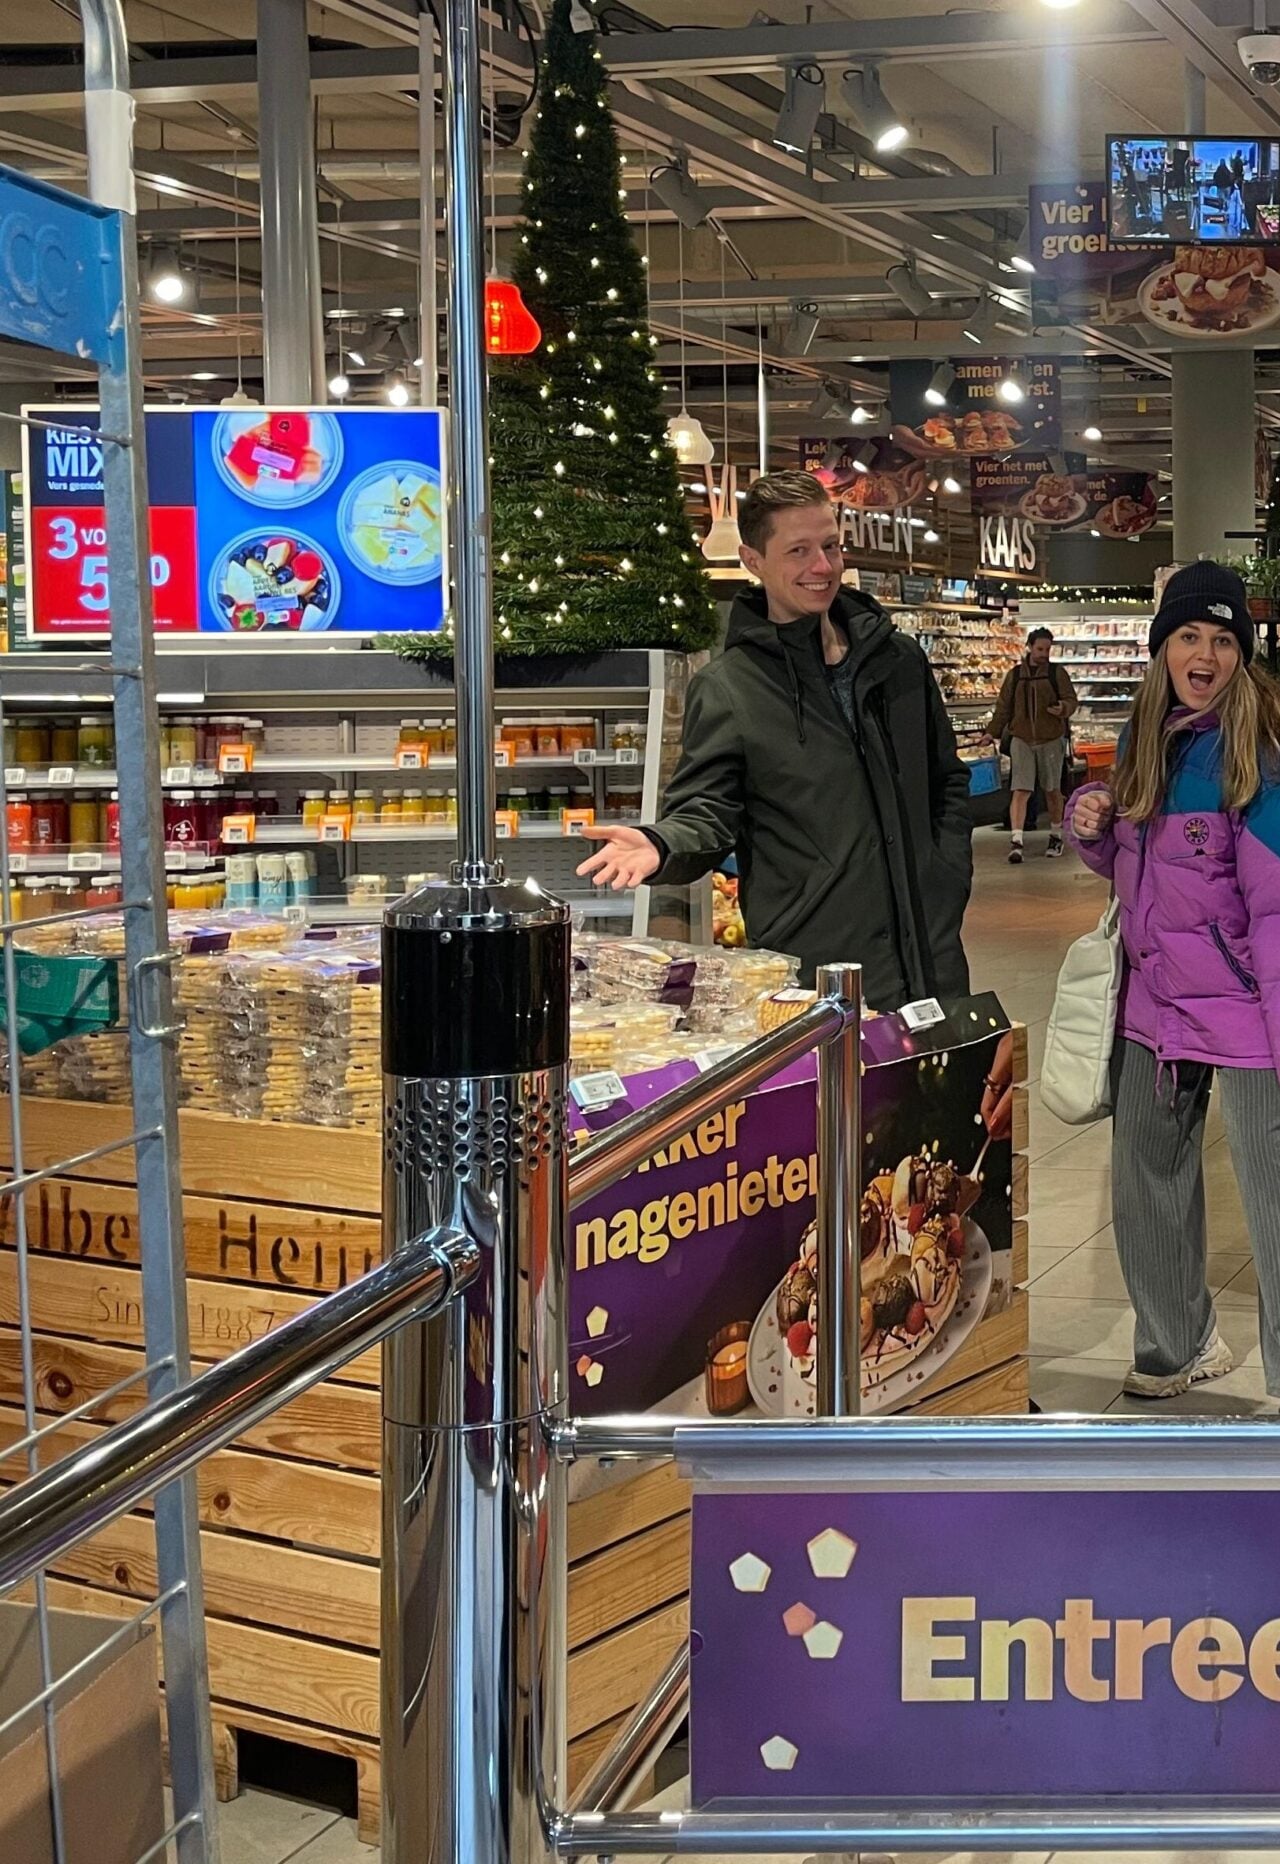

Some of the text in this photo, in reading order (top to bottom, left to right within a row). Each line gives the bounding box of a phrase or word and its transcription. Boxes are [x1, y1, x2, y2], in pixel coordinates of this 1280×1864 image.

[1041, 200, 1093, 224] Vier
[957, 365, 1002, 378] amen
[976, 461, 999, 473] Vier
[1025, 461, 1048, 472] met
[976, 474, 1031, 488] groenten.
[49, 517, 78, 559] 3
[980, 515, 1036, 571] KAAS
[198, 1302, 276, 1341] 1887
